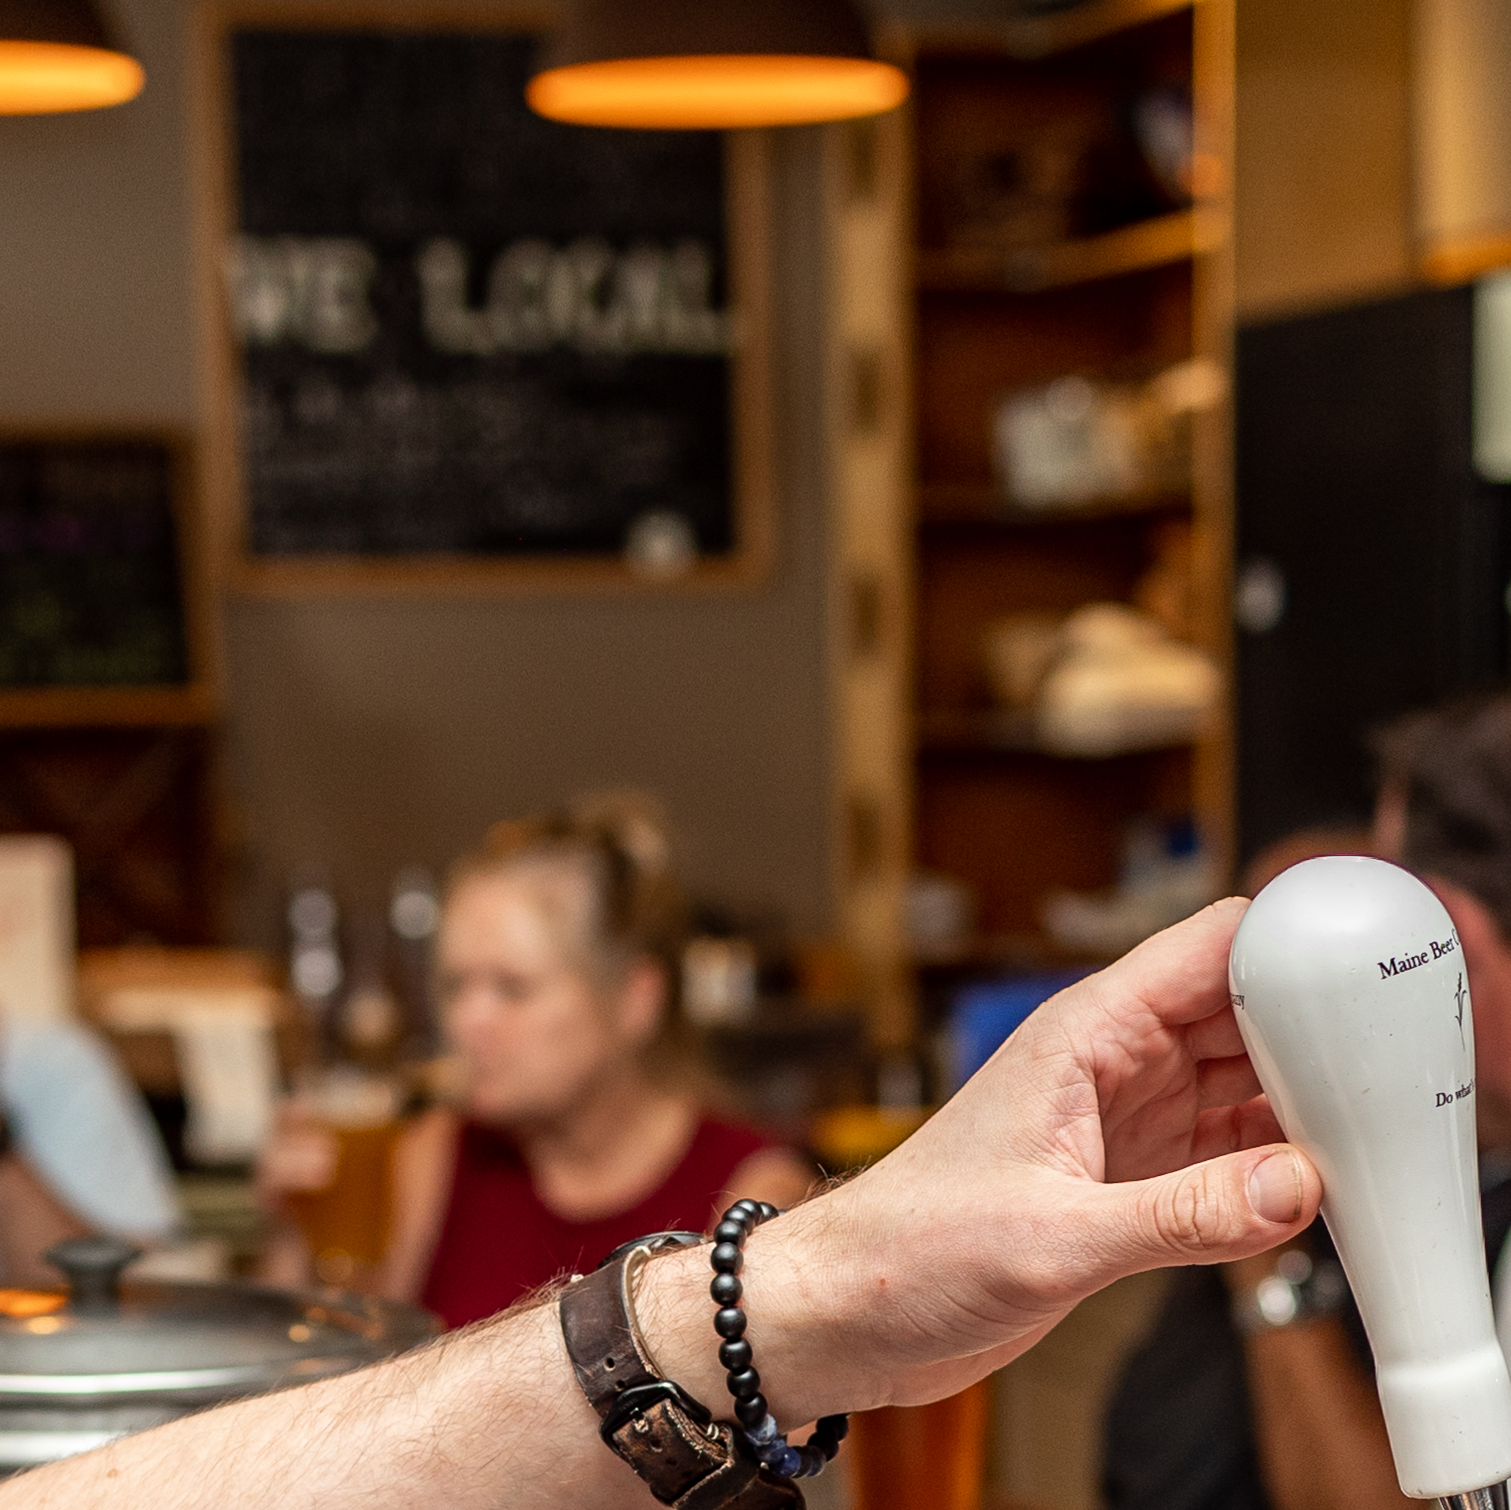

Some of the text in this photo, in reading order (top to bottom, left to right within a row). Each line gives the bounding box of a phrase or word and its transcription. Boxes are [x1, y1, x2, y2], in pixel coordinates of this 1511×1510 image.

[1377, 938, 1455, 980] Maine Beer
[1435, 1091, 1454, 1108] Do
